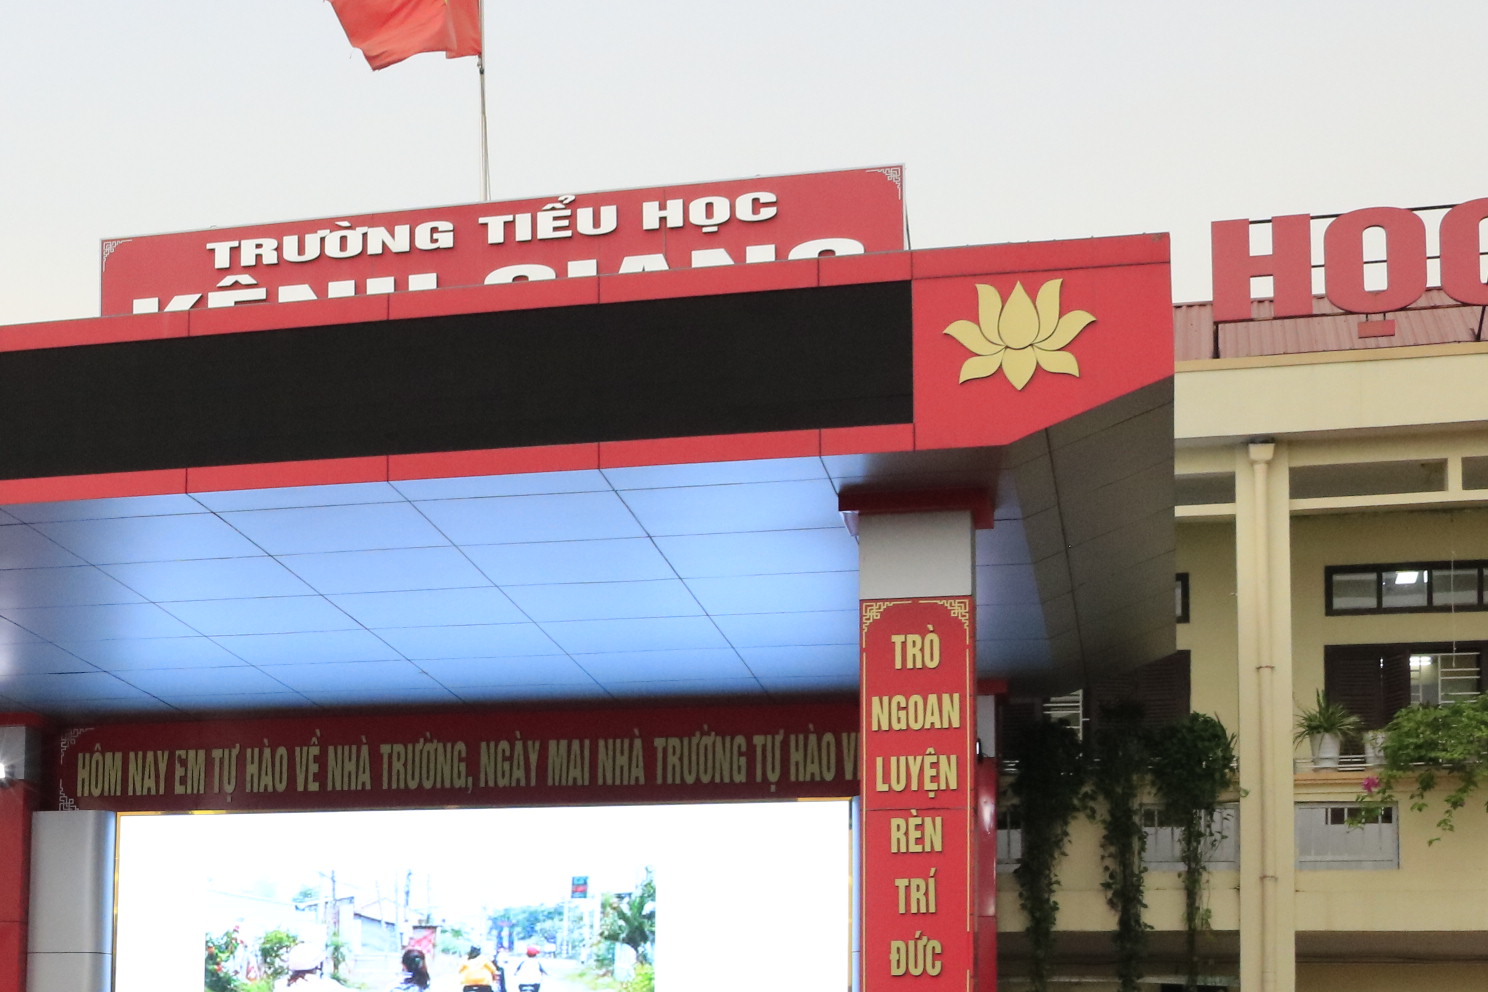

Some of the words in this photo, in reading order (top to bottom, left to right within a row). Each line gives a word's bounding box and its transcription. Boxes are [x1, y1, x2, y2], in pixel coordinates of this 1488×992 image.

[206, 221, 454, 269] TRƯỜNG
[478, 194, 618, 245] TIỂU
[642, 191, 778, 233] HỌC
[891, 624, 940, 670] TRÒ
[871, 693, 961, 732] NGOAN
[76, 742, 123, 798] HÔM
[127, 750, 170, 797] NAY
[174, 749, 206, 796] EM
[211, 743, 241, 803] TỰ
[245, 737, 288, 793] HÀO
[294, 729, 321, 793] VỀ
[327, 735, 372, 792] NHÀ
[380, 732, 473, 794] TRƯỜNG,
[479, 730, 541, 788] NGÀY
[547, 738, 591, 787] MAI
[597, 728, 646, 787] NHÀ
[653, 724, 747, 785] TRƯỜNG
[752, 729, 785, 793] TỰ
[789, 723, 836, 783] HÀO
[841, 730, 861, 781] V
[875, 747, 958, 798] LUYỆN
[890, 809, 943, 853] RÈN
[894, 868, 937, 914] TRÍ
[889, 930, 943, 977] ĐỨC
